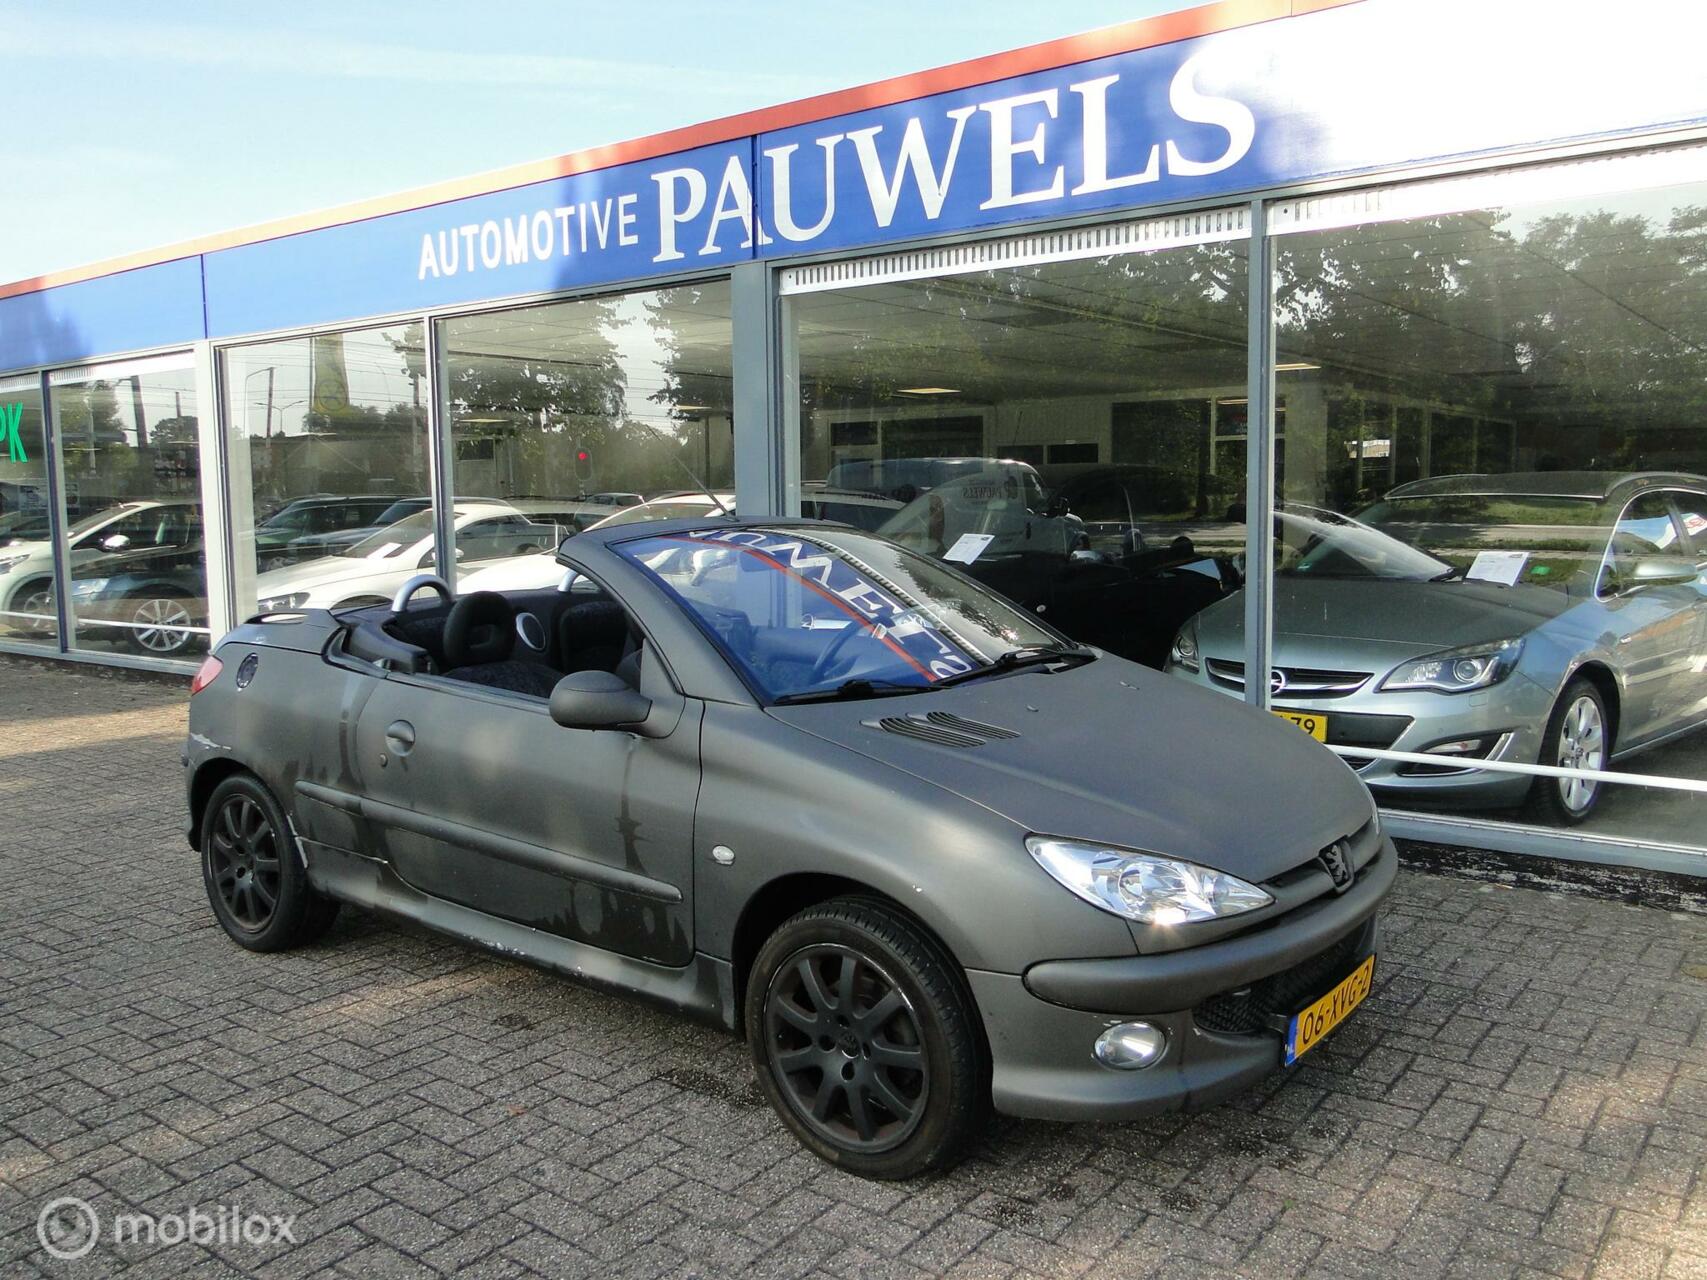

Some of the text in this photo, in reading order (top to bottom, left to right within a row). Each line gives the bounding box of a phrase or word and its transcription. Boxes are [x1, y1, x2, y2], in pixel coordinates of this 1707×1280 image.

[419, 50, 1257, 281] AUTOMOTIVE PAUWELS
[1302, 965, 1370, 1045] 06-XVG-2
